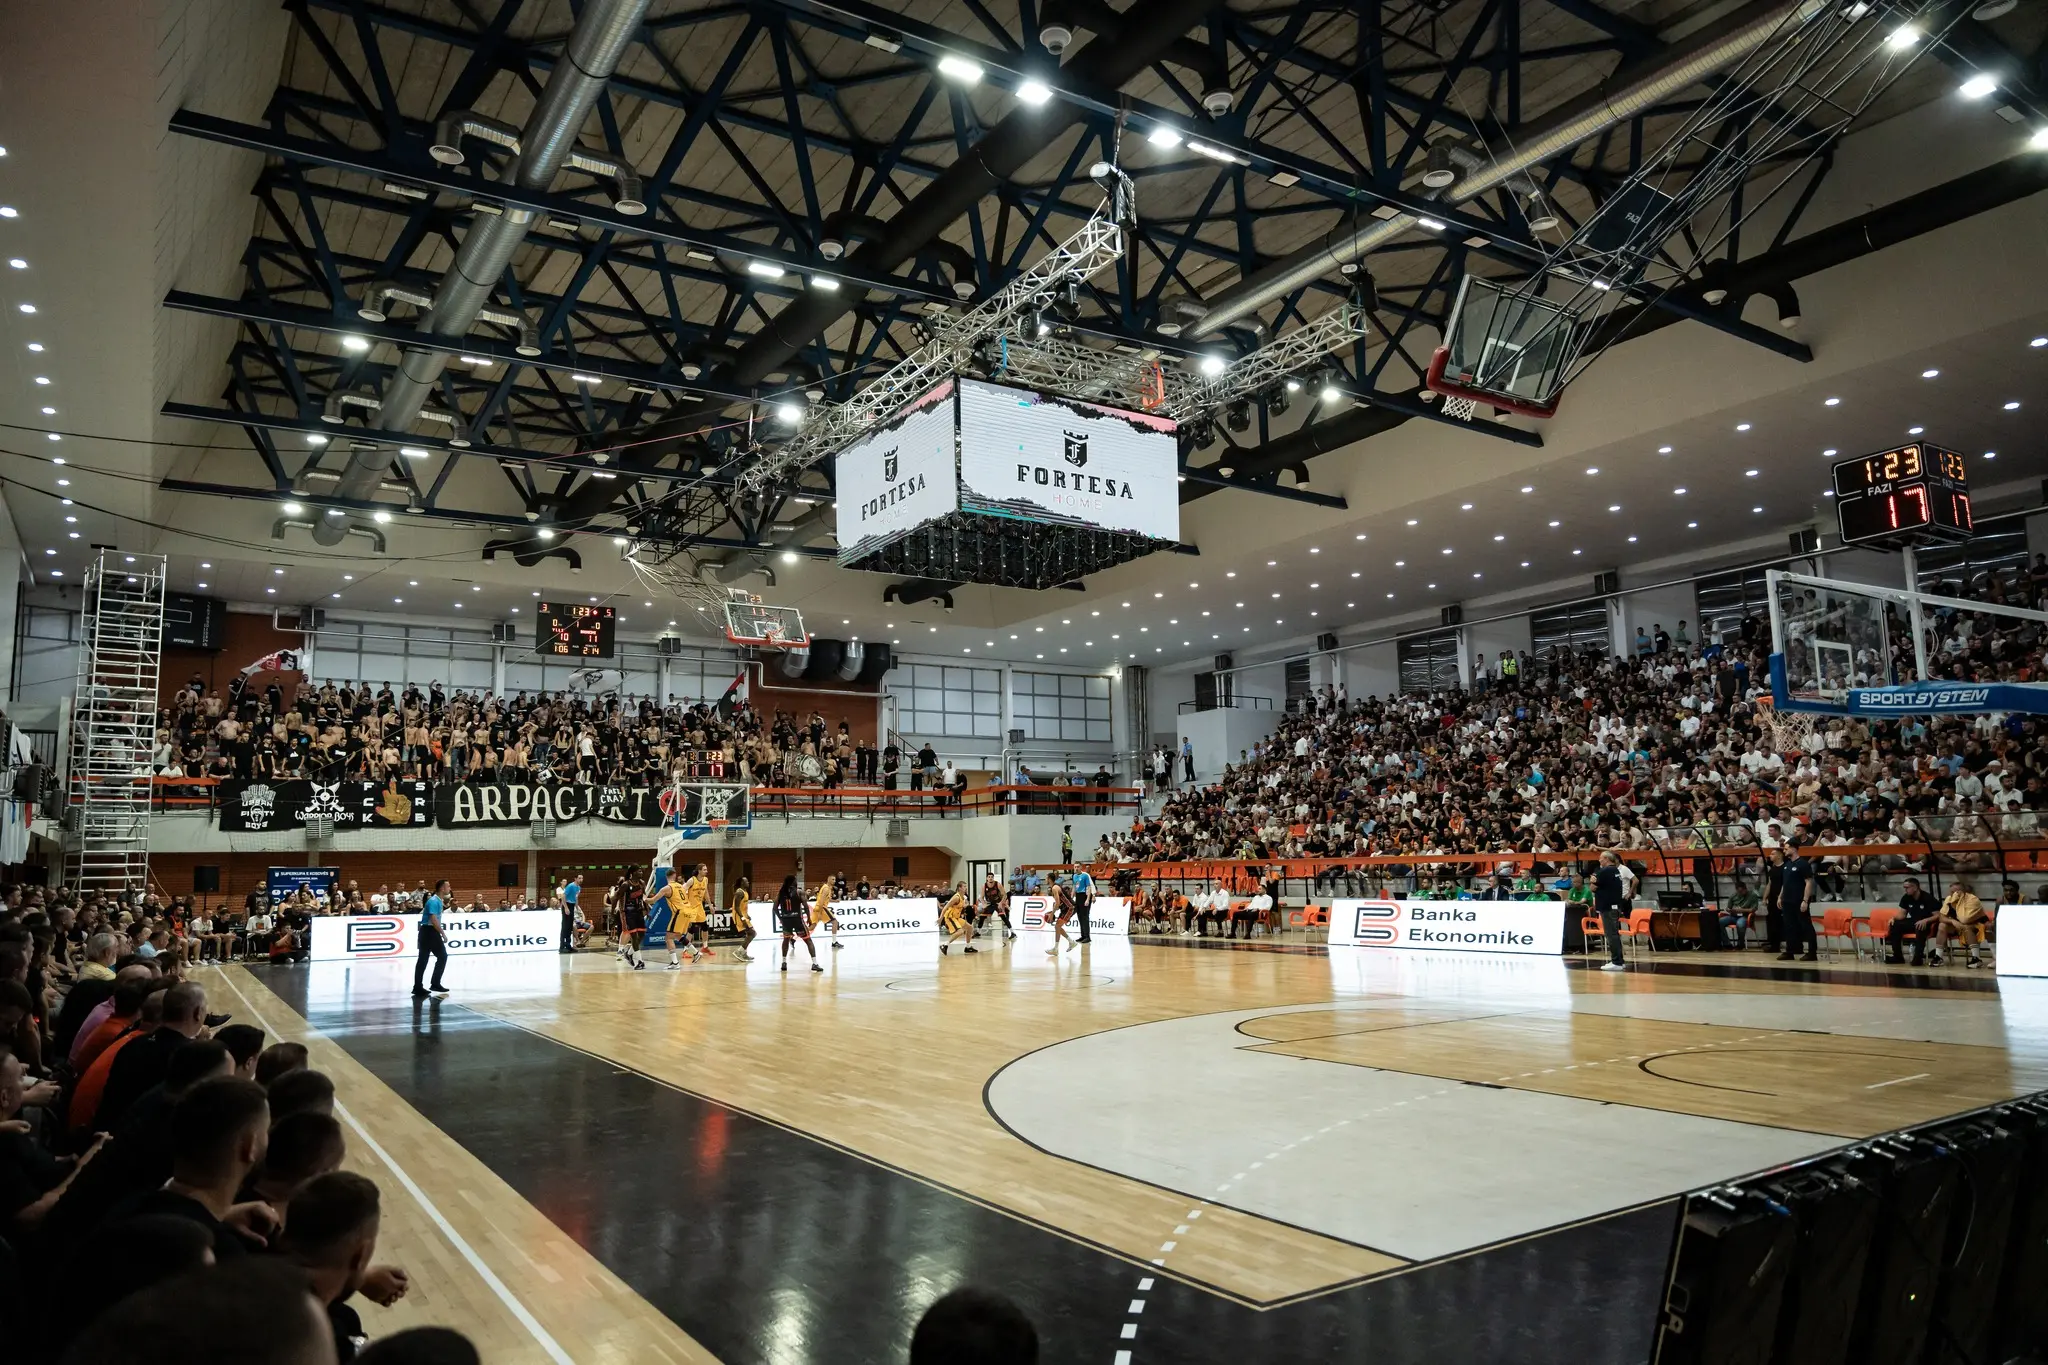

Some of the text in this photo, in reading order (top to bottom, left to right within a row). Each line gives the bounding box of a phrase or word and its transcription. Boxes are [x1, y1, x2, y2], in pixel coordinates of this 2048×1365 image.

[1865, 447, 1920, 483] 1:23
[1017, 464, 1134, 500] FORTESA
[861, 472, 926, 521] FORTESA
[1867, 482, 1893, 497] FAZI
[1052, 493, 1103, 510] HOME
[1889, 487, 1928, 529] 17
[1952, 493, 1972, 529] 17
[541, 603, 548, 611] 3
[572, 607, 590, 616] 1:23
[560, 632, 569, 641] 10
[589, 635, 598, 643] 11
[1859, 689, 1989, 707] SPORTSYSTEM
[706, 751, 723, 761] 1:23
[711, 764, 723, 776] 17
[452, 784, 650, 823] ARPAGJT
[786, 899, 792, 911] 11
[1411, 908, 1477, 922] Banka
[417, 920, 490, 931] anka
[447, 935, 548, 949] onomike
[1408, 928, 1534, 945] Ekonomike
